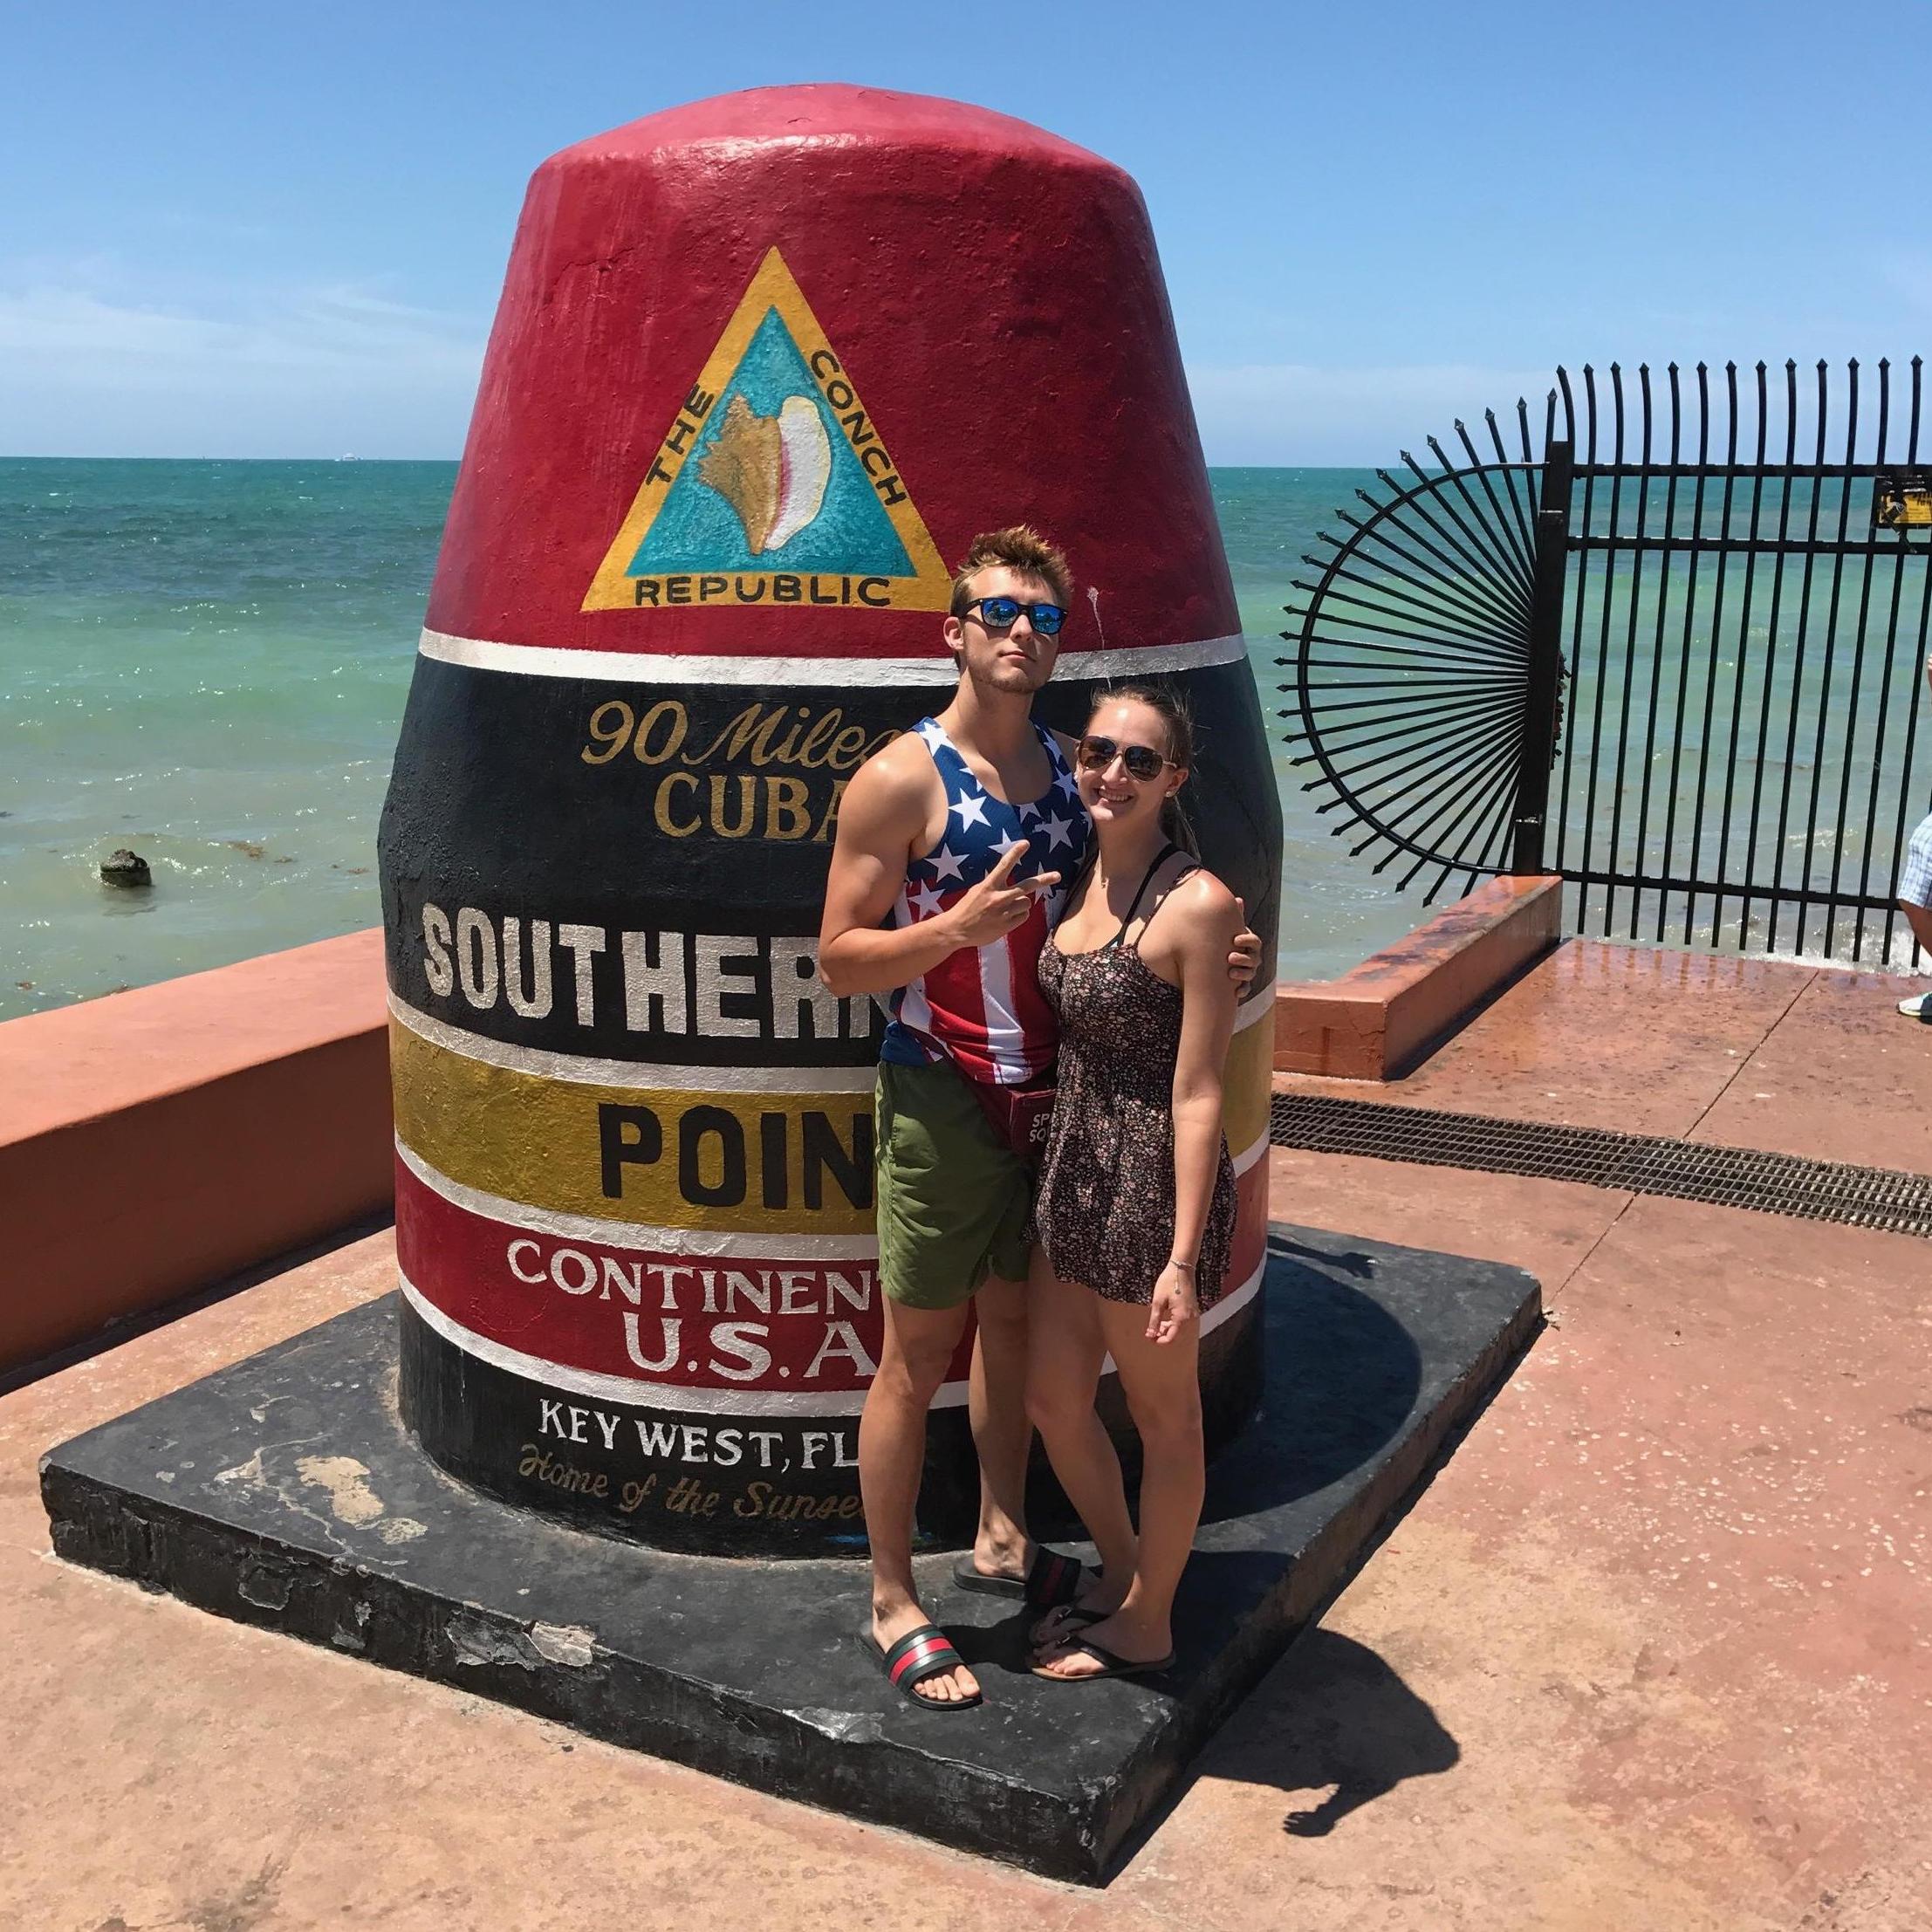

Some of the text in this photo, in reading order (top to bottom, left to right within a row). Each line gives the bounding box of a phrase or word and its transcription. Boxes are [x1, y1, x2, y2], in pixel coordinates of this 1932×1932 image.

[645, 384, 715, 486] THE
[811, 350, 908, 505] CONCH
[634, 574, 891, 606] REPUBLIC
[581, 700, 688, 765] 90
[1031, 1113, 1052, 1127] SP
[506, 1239, 880, 1315] CONTINEN
[538, 1398, 620, 1450] KEY
[634, 1419, 791, 1473] WEST,
[518, 1443, 866, 1520] Home of the Sunse
